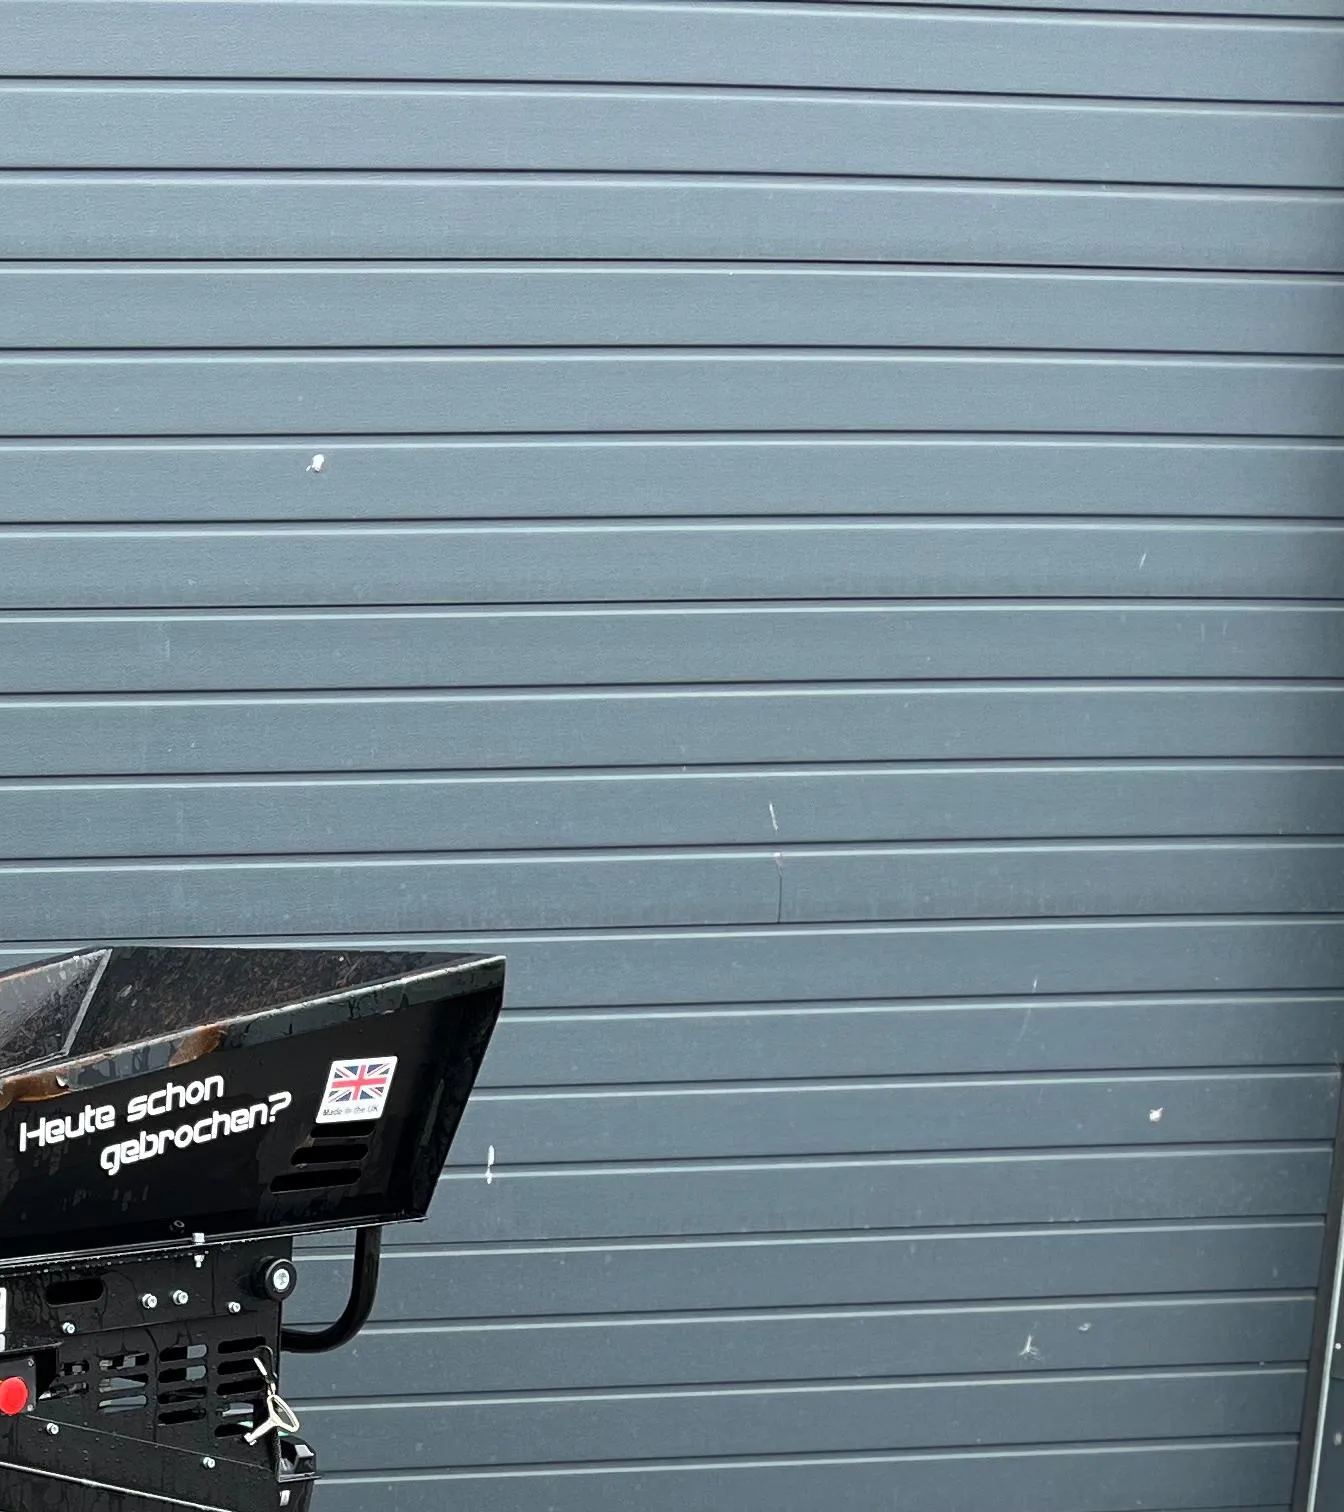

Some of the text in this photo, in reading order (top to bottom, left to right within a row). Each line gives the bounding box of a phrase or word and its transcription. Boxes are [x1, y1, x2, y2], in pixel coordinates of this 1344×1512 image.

[19, 1075, 225, 1152] Heute schon
[100, 1091, 292, 1176] gebrochen?
